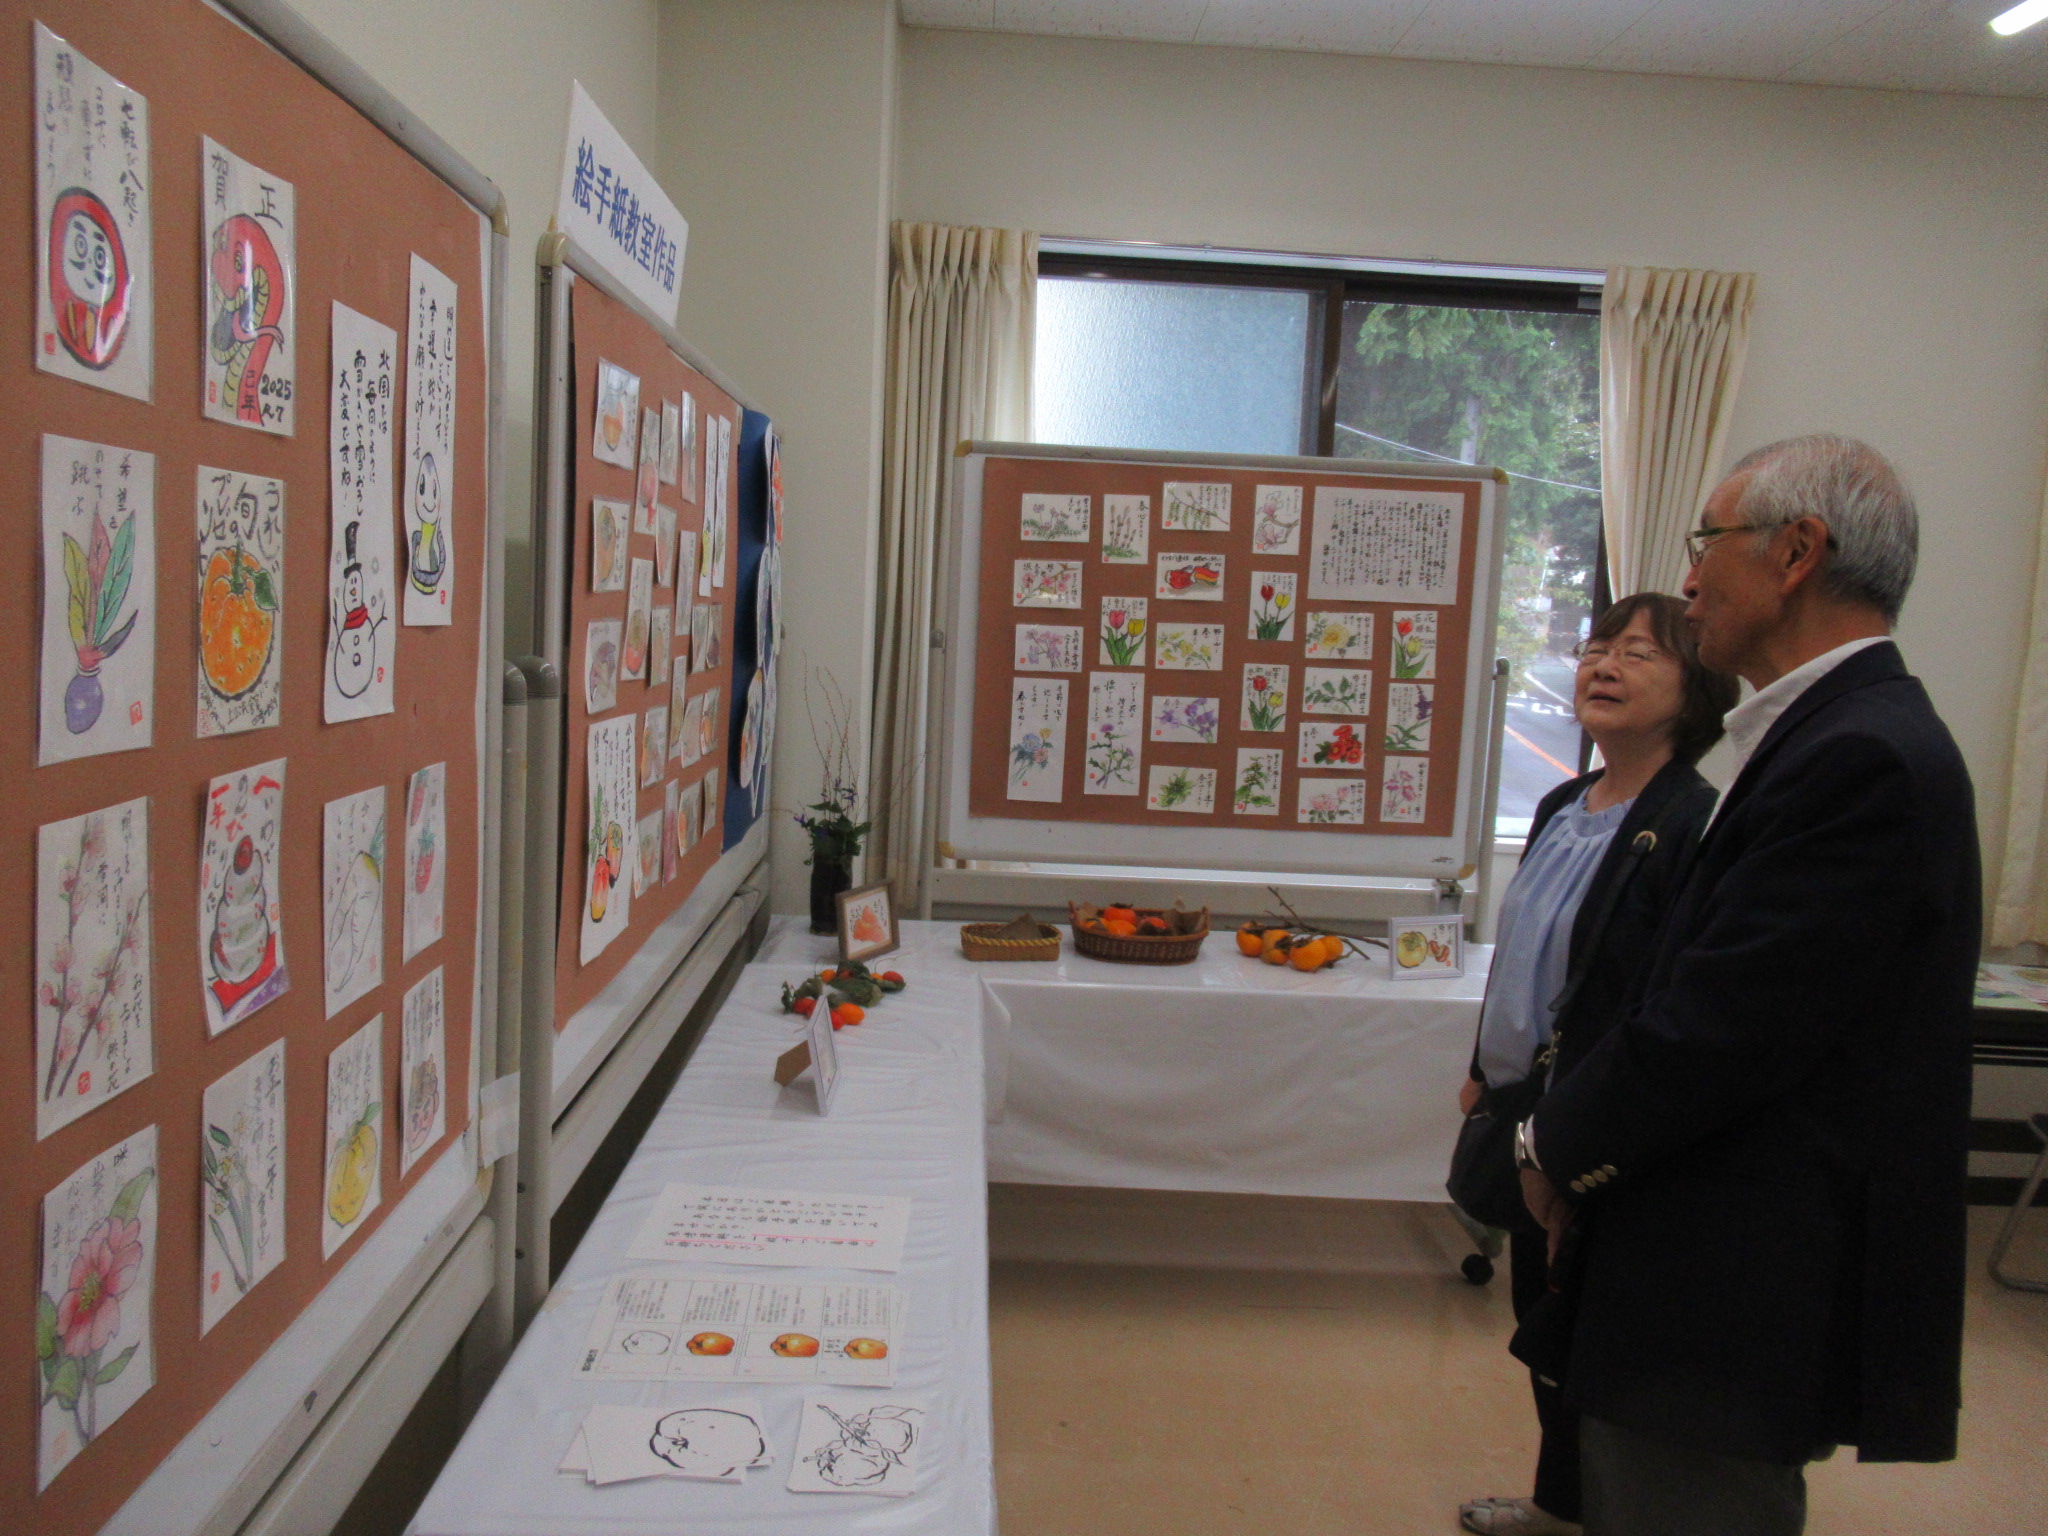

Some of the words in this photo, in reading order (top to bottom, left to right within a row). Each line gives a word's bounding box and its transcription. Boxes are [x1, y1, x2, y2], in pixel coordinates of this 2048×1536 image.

[572, 136, 677, 294] 絵手紙教室作品
[261, 373, 292, 400] 2025
